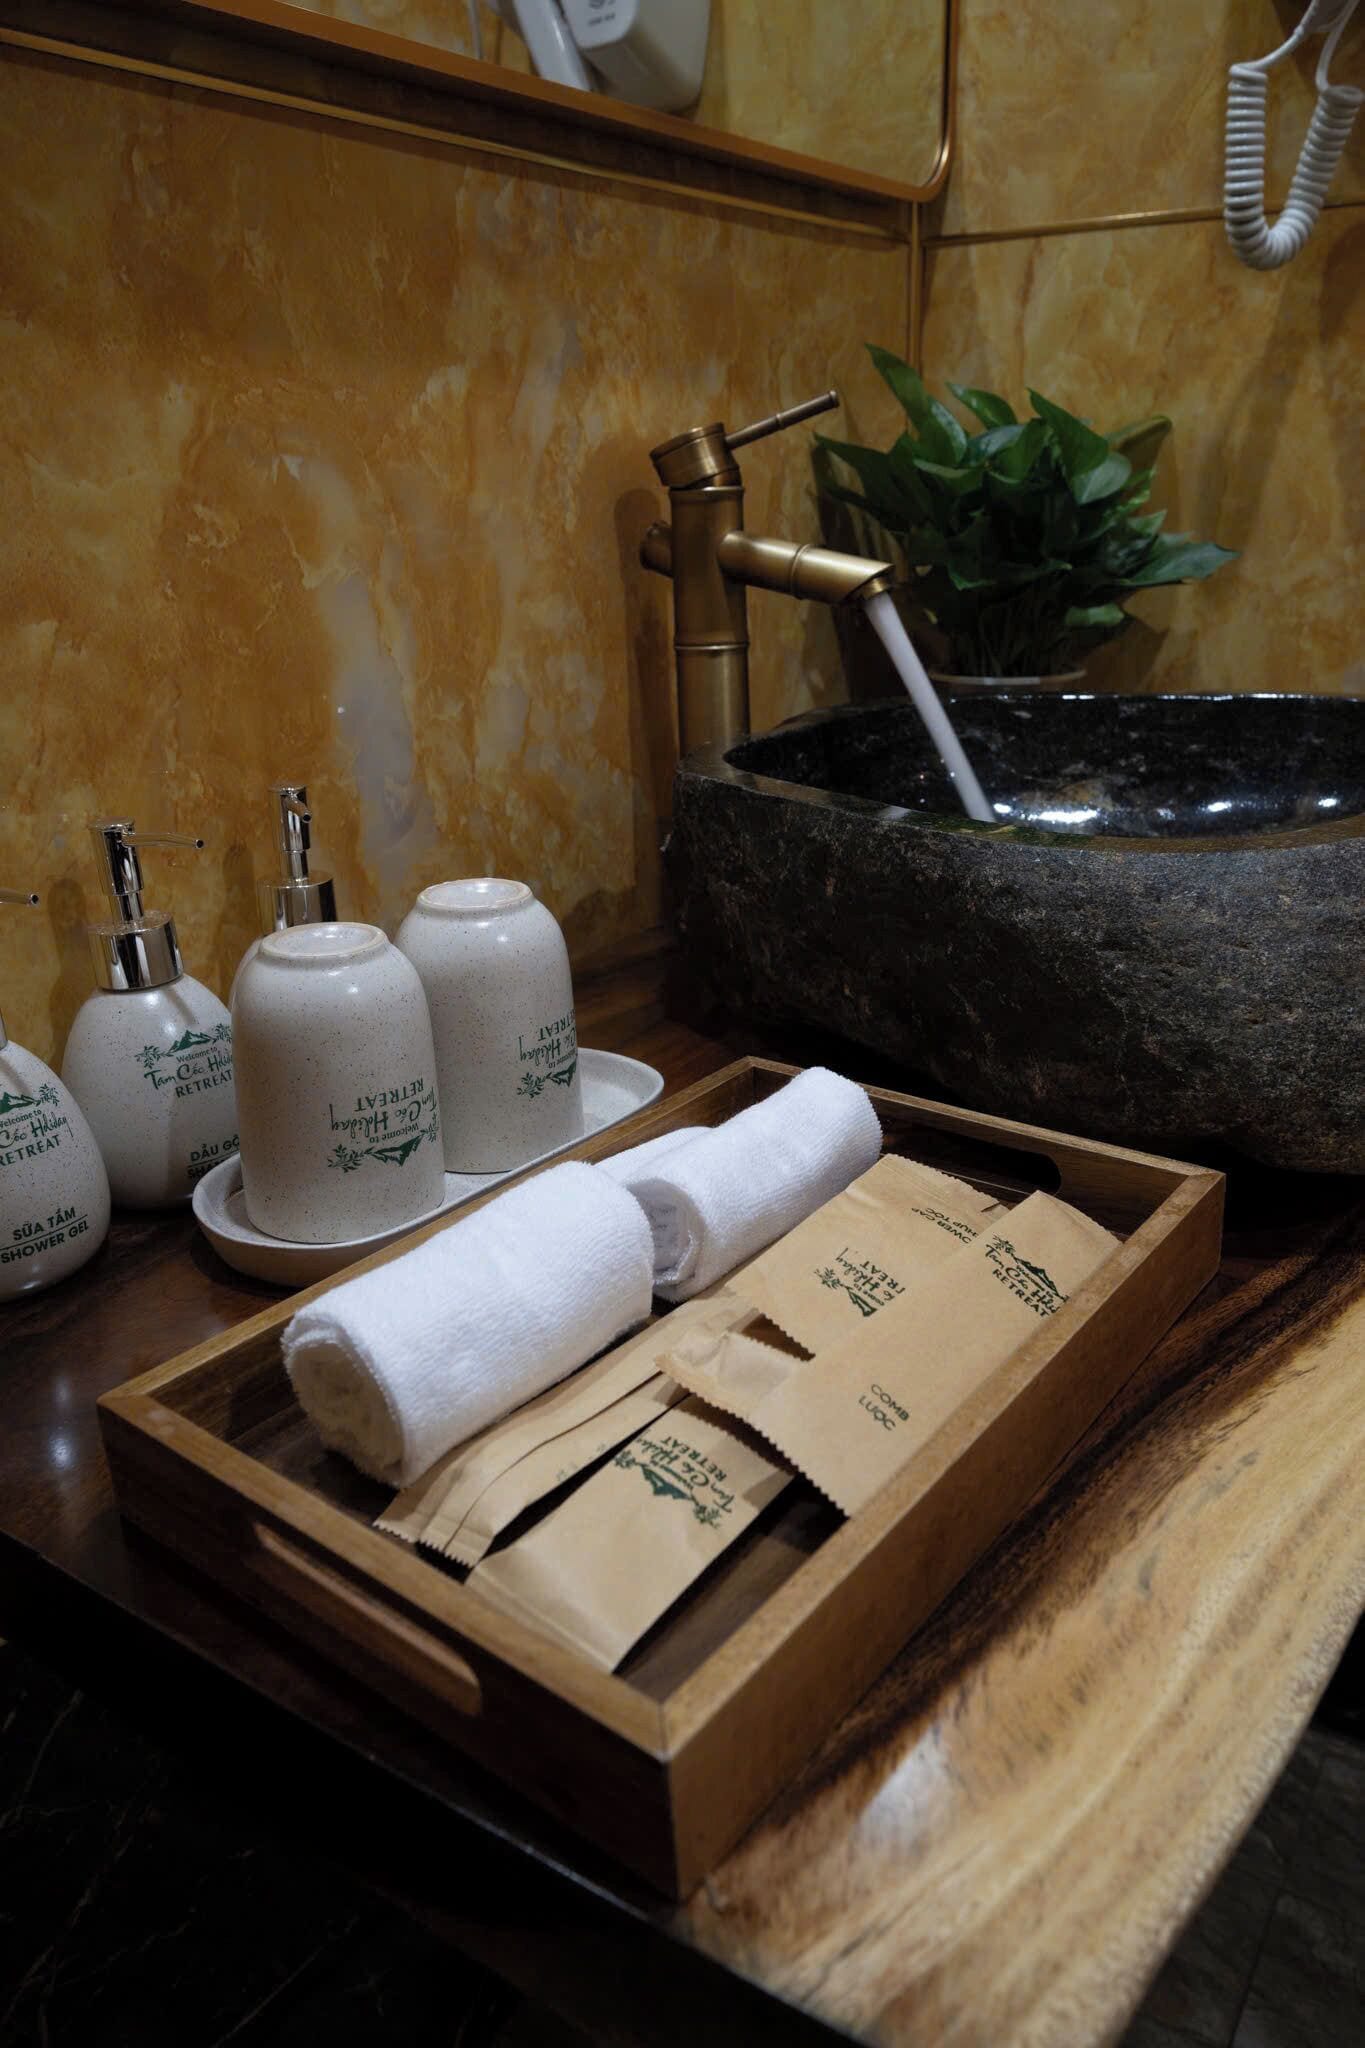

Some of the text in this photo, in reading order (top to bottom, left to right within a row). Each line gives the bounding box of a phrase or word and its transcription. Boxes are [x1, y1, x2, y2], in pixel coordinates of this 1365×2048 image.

[176, 1049, 210, 1064] Welcome
[144, 1069, 176, 1090] Tam
[175, 1069, 232, 1098] RETREAT
[354, 1077, 425, 1113] RETREAT
[31, 1112, 74, 1138] Holiday
[33, 1109, 43, 1118] to
[329, 1103, 389, 1139] Holiday
[369, 1122, 419, 1144] Welcome to
[1, 1220, 89, 1264] SHOWER GEL
[984, 1243, 1004, 1270] Tam
[835, 1247, 880, 1293] Holiday
[991, 1268, 1050, 1319] RETREAT
[870, 1383, 910, 1422] COMB
[660, 1436, 728, 1482] RETREAT
